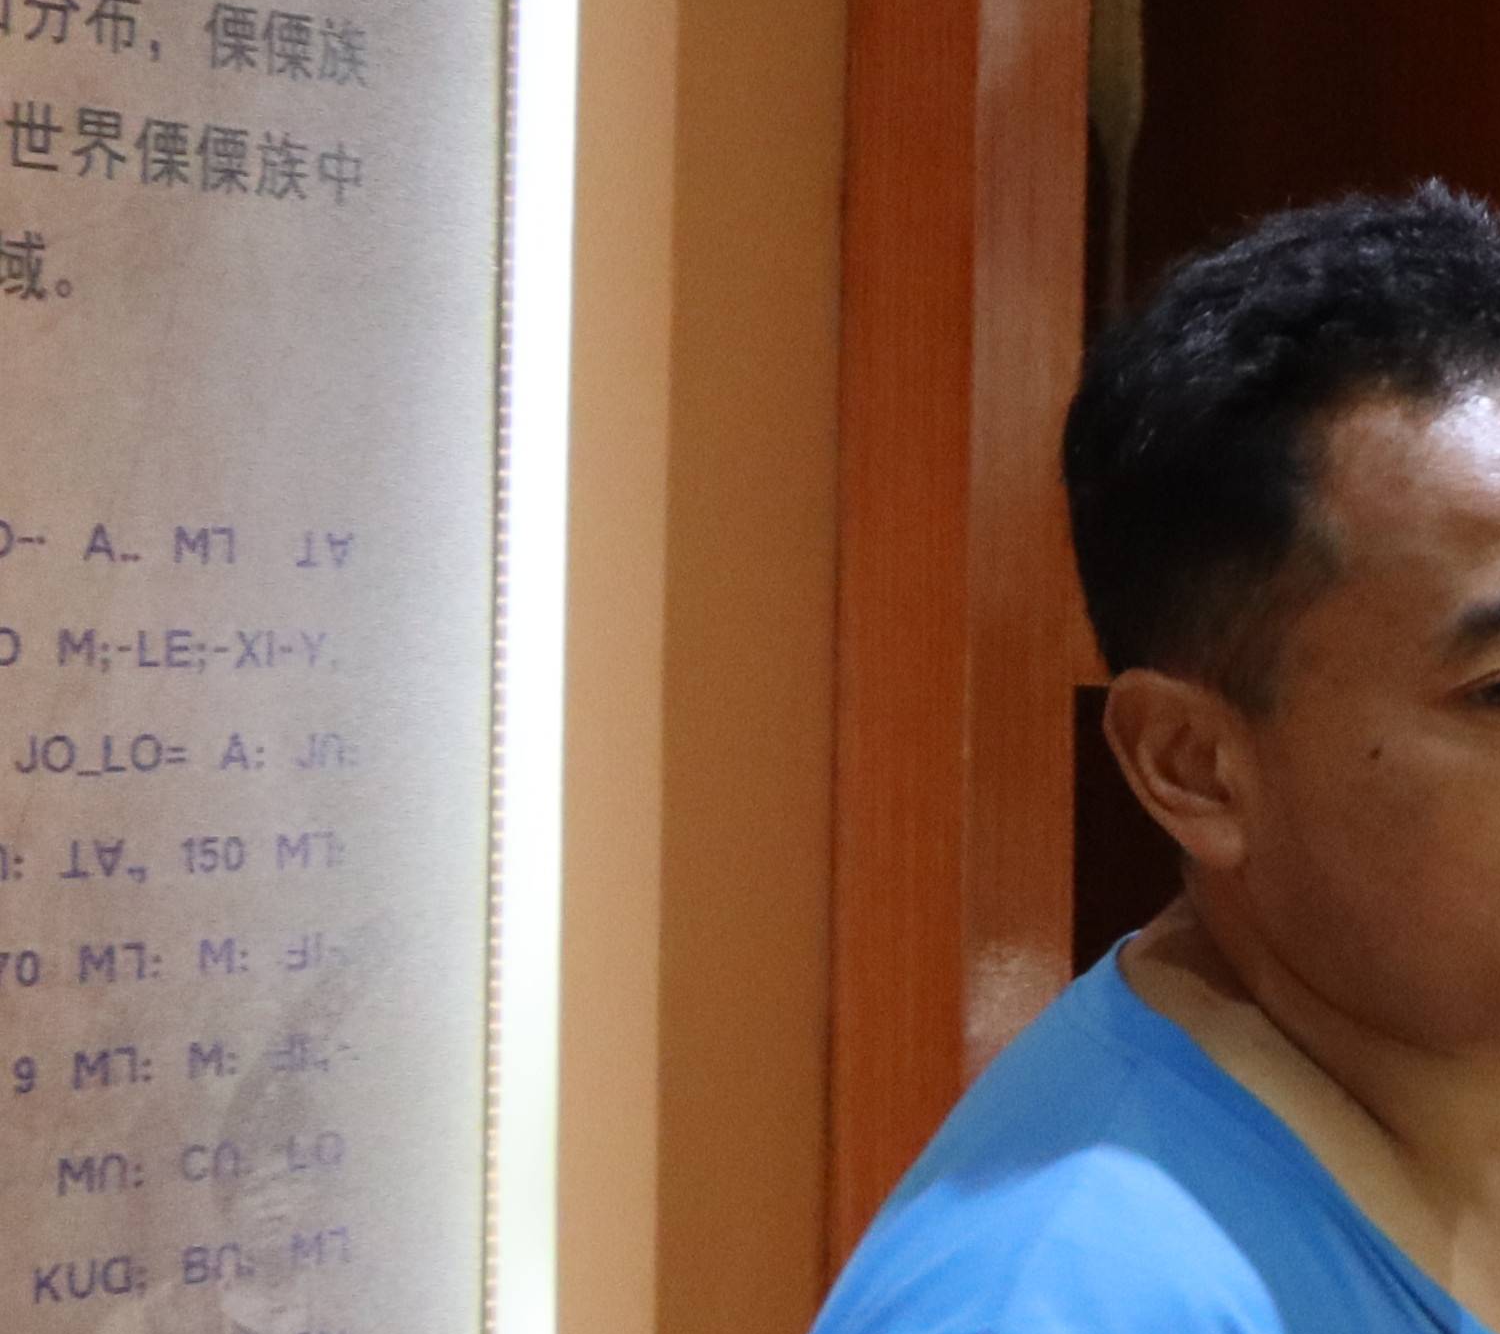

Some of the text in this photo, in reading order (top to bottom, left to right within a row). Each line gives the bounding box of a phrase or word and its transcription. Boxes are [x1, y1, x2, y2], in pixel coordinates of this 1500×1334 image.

[5, 100, 362, 205] 世界傈僳族中
[182, 835, 247, 874] 150
